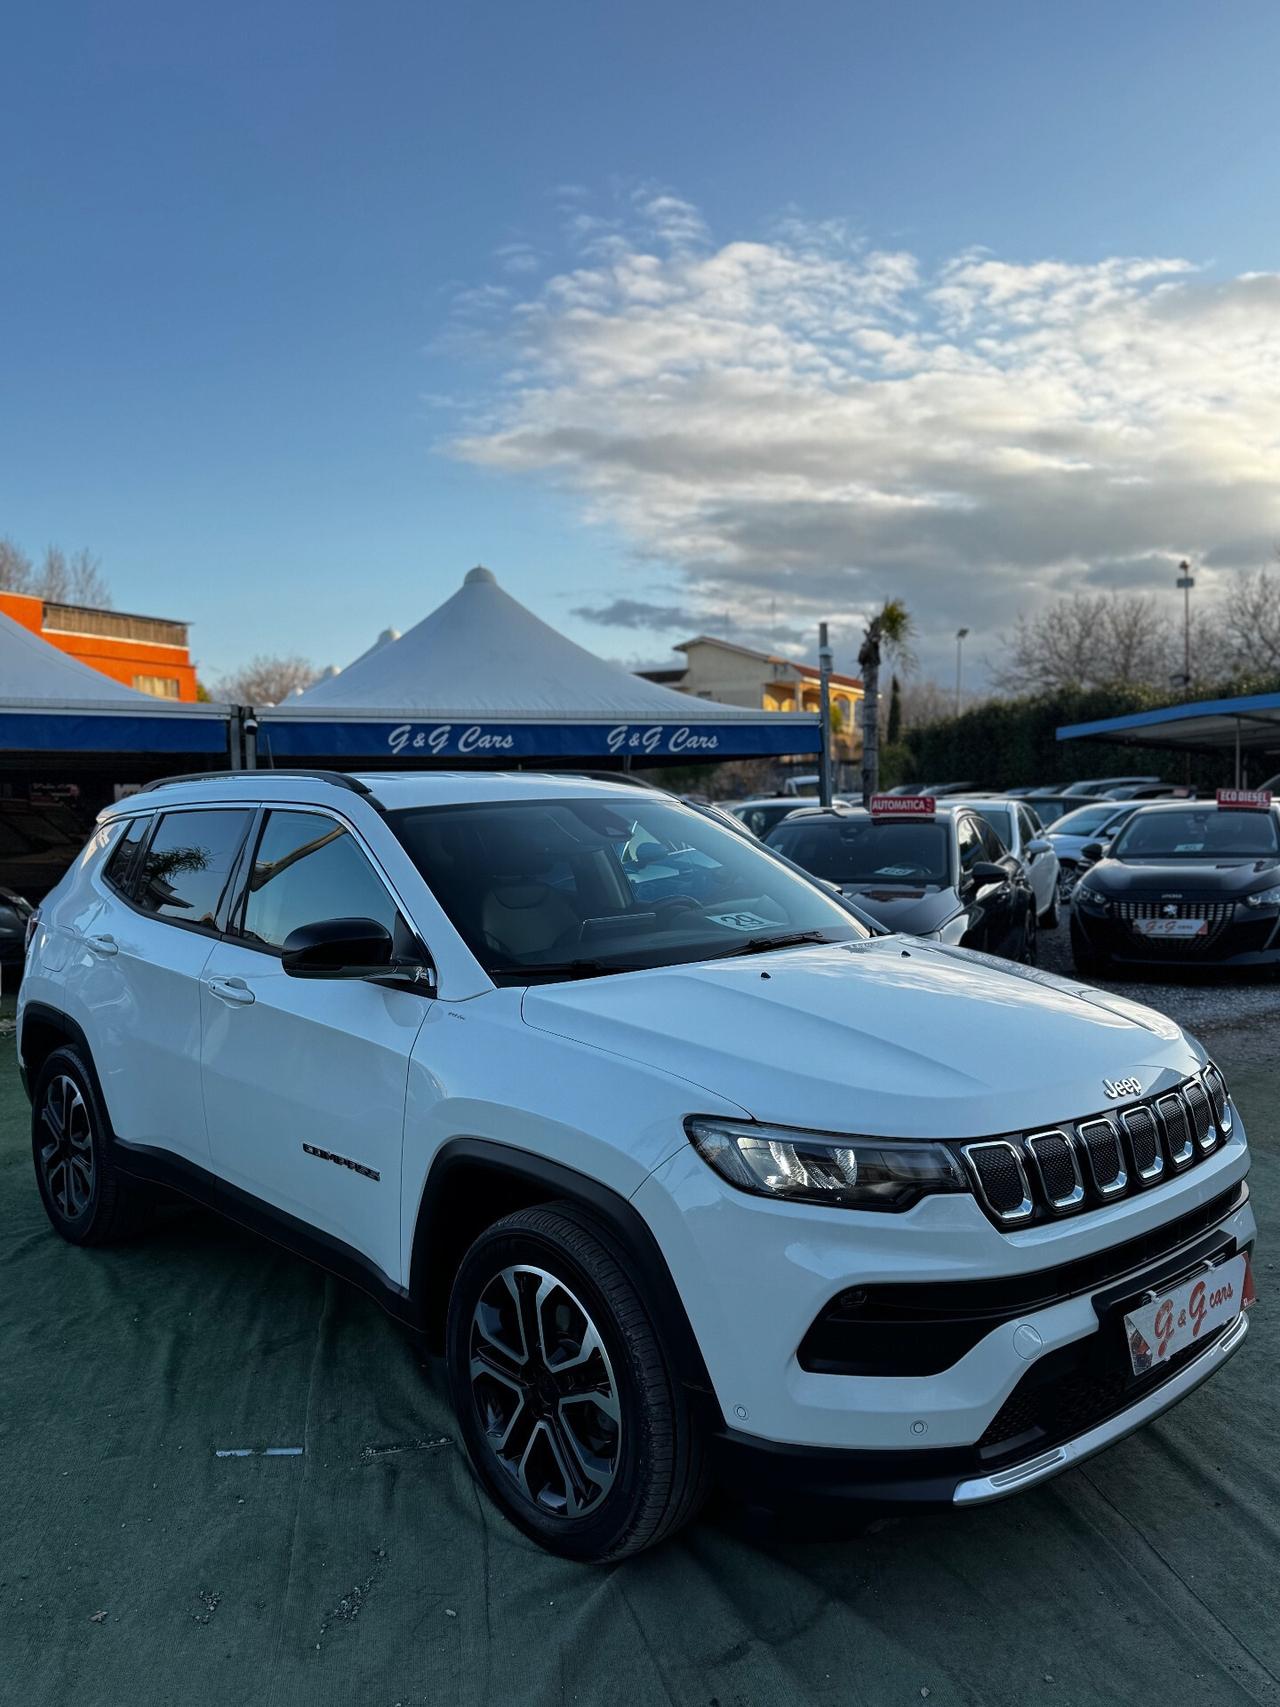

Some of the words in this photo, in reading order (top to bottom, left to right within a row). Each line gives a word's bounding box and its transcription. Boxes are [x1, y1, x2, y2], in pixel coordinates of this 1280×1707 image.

[458, 726, 514, 752] Cars
[668, 727, 719, 752] Cars
[872, 800, 925, 810] AUTOMATICA
[1220, 791, 1236, 802] ECO
[1238, 791, 1267, 803] DIESEL
[1103, 1077, 1141, 1099] Jeep
[1155, 1300, 1174, 1357] G
[1189, 1281, 1207, 1337] G
[1209, 1282, 1233, 1308] cars
